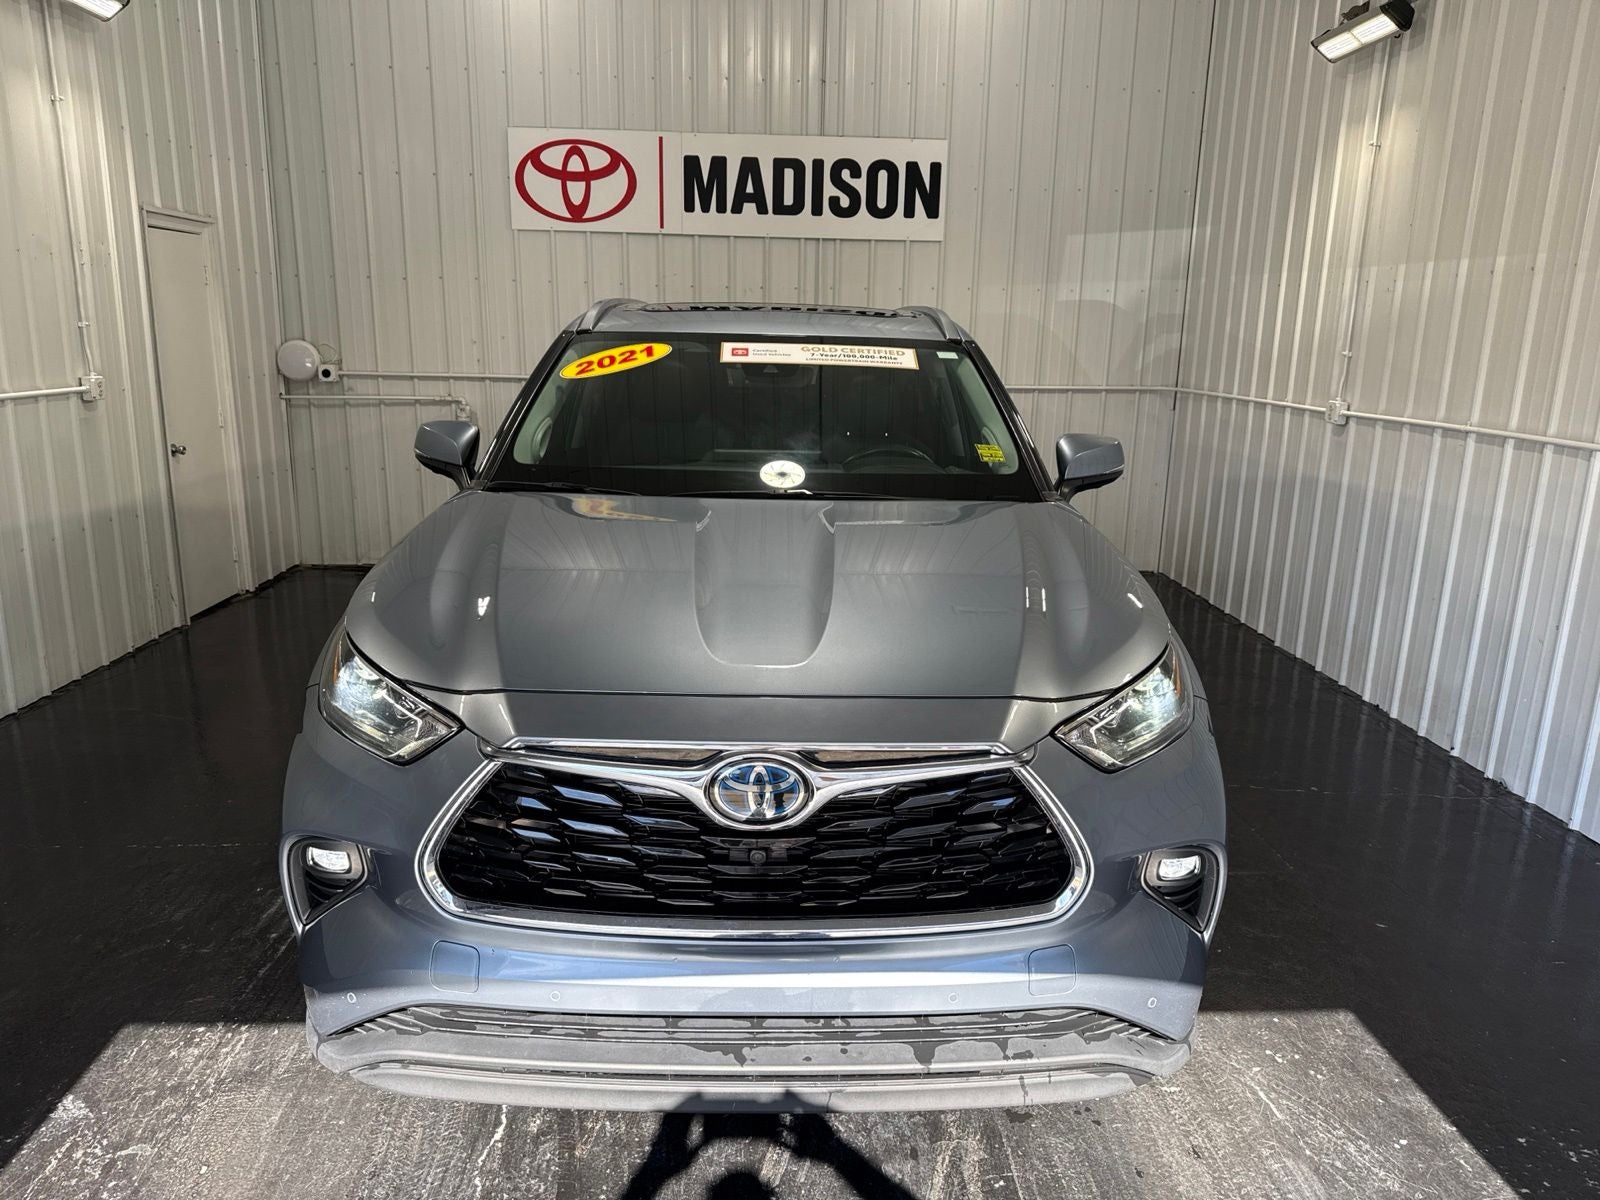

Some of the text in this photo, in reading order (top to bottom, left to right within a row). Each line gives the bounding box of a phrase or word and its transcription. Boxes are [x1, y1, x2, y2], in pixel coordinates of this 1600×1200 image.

[683, 154, 942, 219] MADISON
[575, 345, 654, 376] 2021
[841, 347, 906, 357] CERTIFIED
